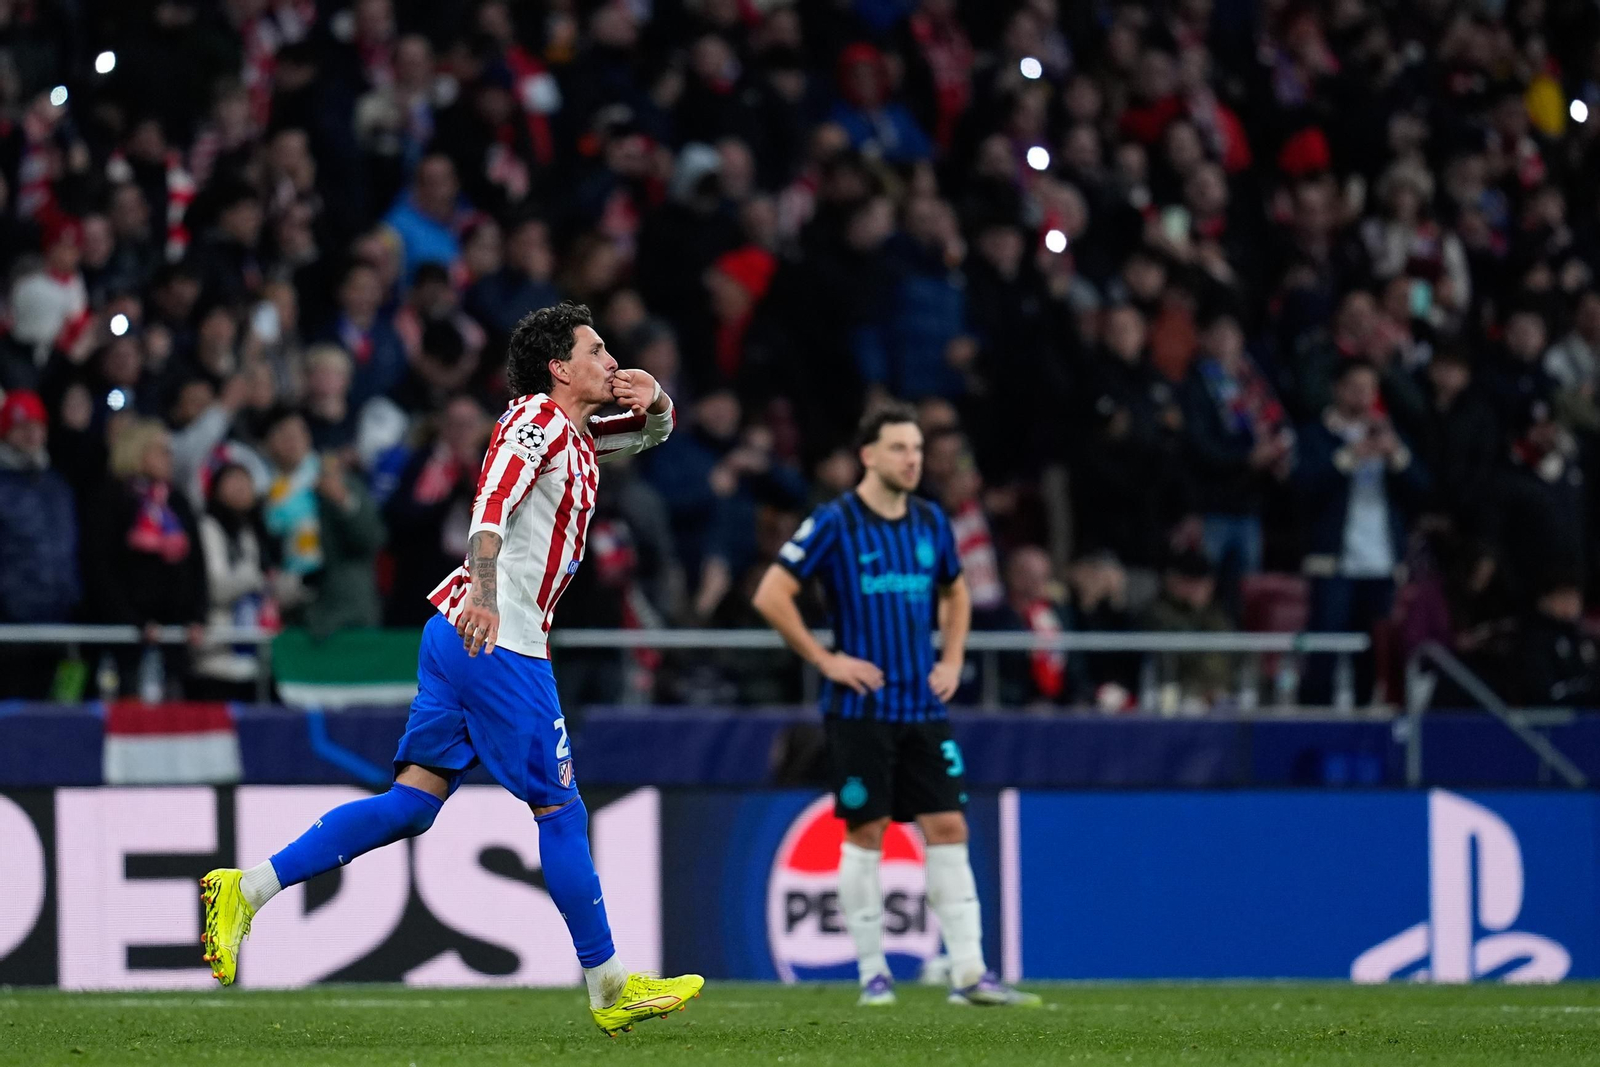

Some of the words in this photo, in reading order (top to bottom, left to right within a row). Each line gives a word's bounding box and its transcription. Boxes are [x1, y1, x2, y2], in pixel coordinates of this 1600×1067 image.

[553, 717, 569, 760] 2
[939, 738, 965, 778] 3
[784, 890, 928, 935] PESI
